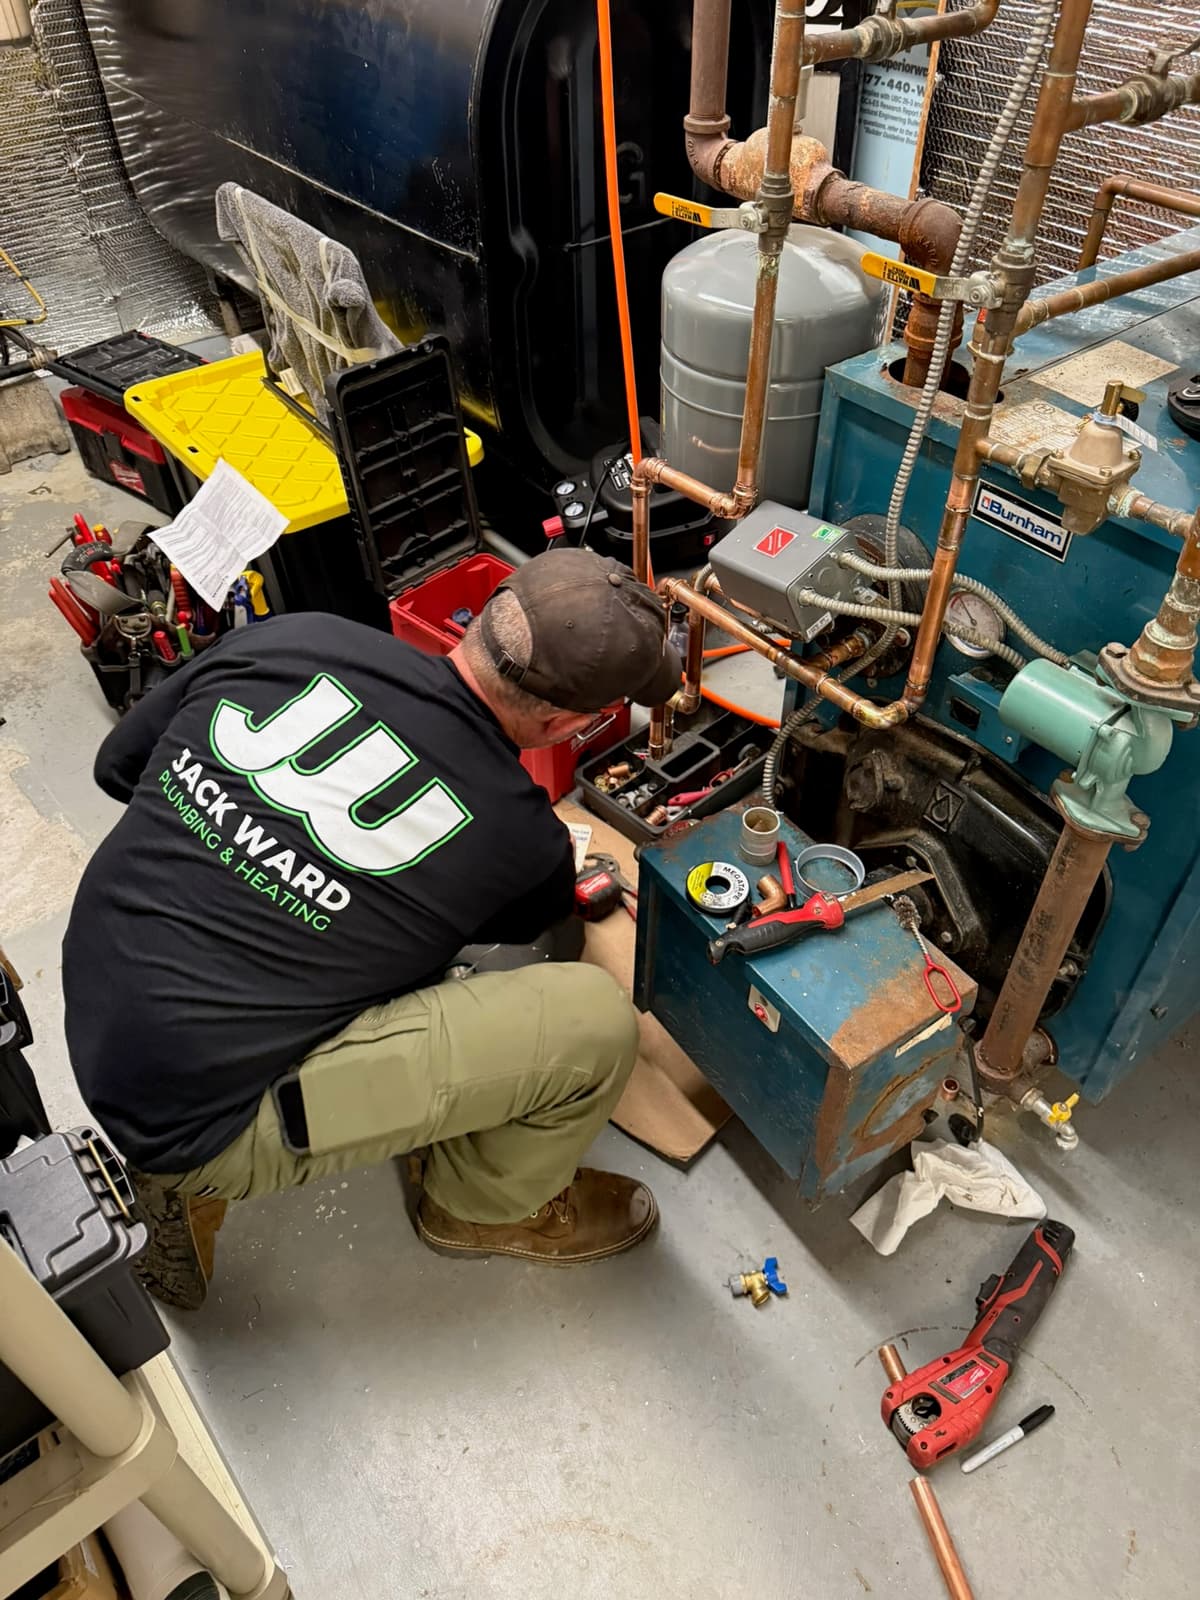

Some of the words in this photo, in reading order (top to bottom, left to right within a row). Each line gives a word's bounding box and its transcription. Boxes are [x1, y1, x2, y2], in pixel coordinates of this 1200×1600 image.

[989, 500, 1062, 545] Burnham
[158, 769, 222, 850] PLUMBING
[219, 847, 235, 865] &
[234, 859, 331, 931] HEATING
[172, 747, 238, 827] JACK
[233, 814, 351, 912] WARD
[722, 866, 745, 900] MEGATAPE
